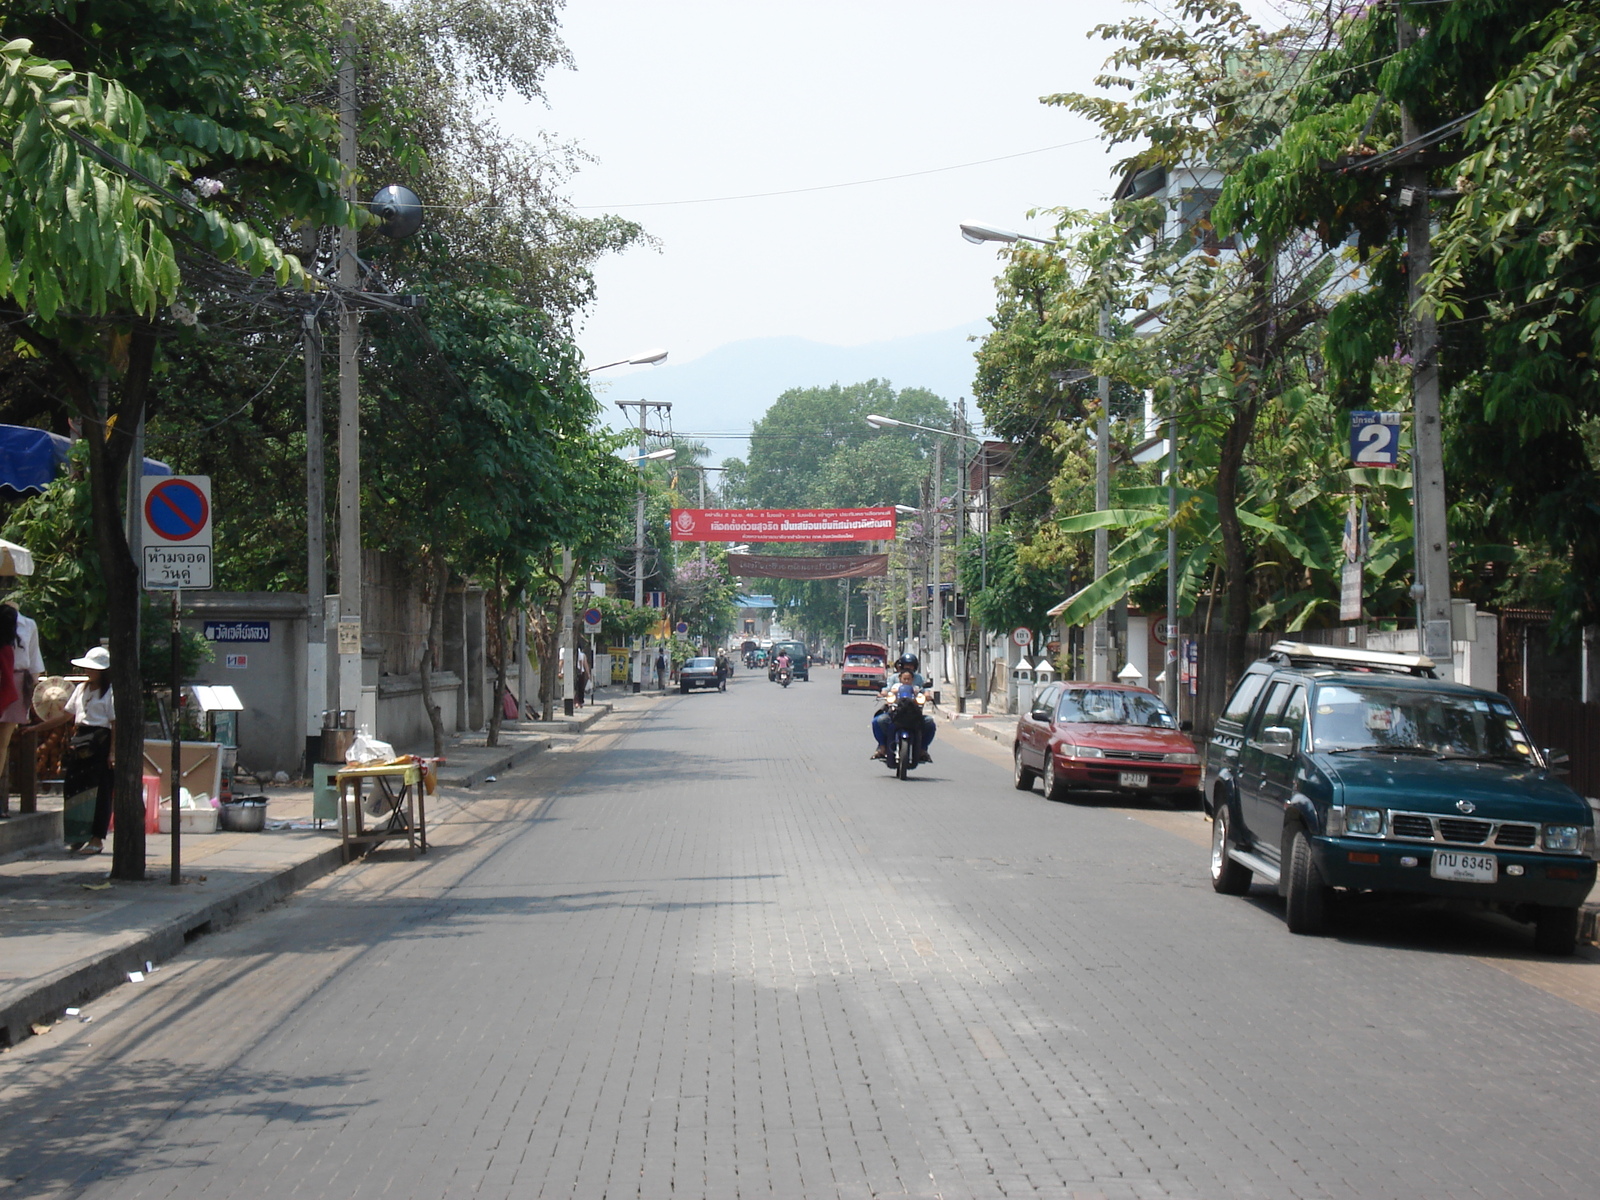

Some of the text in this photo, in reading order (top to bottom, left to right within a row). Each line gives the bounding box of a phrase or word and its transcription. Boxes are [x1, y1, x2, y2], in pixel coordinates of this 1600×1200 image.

[1357, 424, 1391, 462] 2
[710, 518, 779, 533] เลือกตั้งด้วยสุจริต
[148, 547, 206, 564] ห้ามจอด
[161, 564, 191, 585] วันคู่
[215, 623, 269, 640] วัดเจดีย์หลวง
[1439, 853, 1493, 871] กบ 6345
